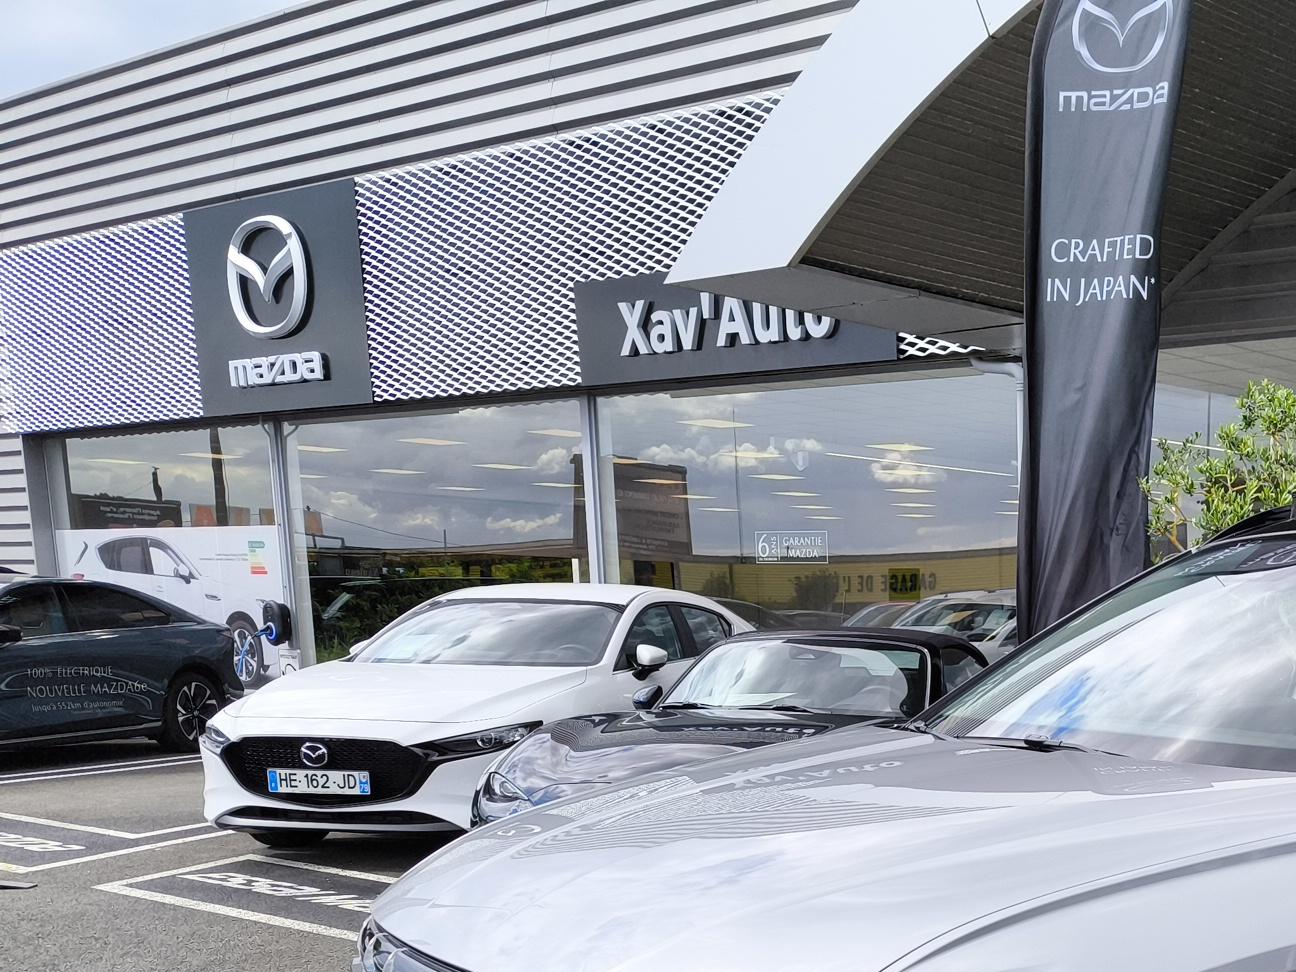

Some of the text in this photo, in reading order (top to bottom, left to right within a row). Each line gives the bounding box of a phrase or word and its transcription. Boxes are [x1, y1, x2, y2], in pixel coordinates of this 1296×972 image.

[1050, 234, 1154, 263] CRAFTED
[1046, 277, 1071, 302] IN
[617, 291, 839, 357] Xav'Auto
[758, 534, 770, 558] 6
[782, 536, 823, 546] GARANTIE
[786, 548, 819, 558] MAZDA
[26, 680, 149, 698] NOUVELLE MAZDA6e
